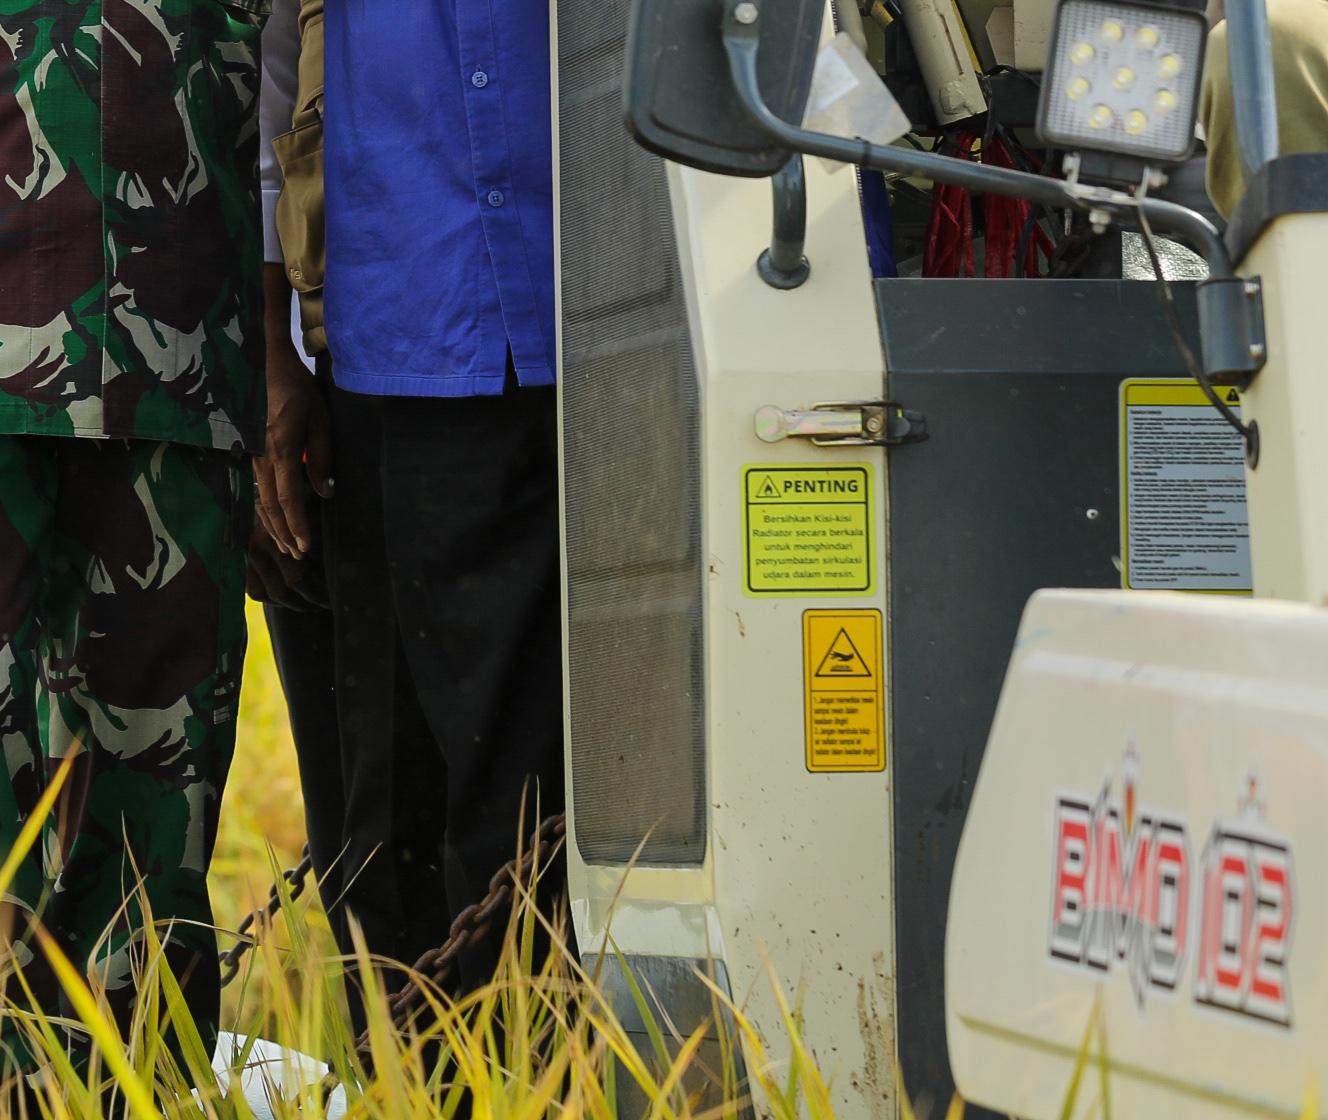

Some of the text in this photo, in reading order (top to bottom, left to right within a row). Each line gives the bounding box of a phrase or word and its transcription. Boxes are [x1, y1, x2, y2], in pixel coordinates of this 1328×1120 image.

[783, 479, 859, 494] PENTING
[763, 513, 852, 524] Bersihkan Kisi-kisi
[752, 528, 864, 538] Radiator secara berkala
[763, 542, 853, 554] untuk menghindari
[755, 555, 863, 567] penyumbatan sirkulasi
[792, 569, 822, 579] dalam
